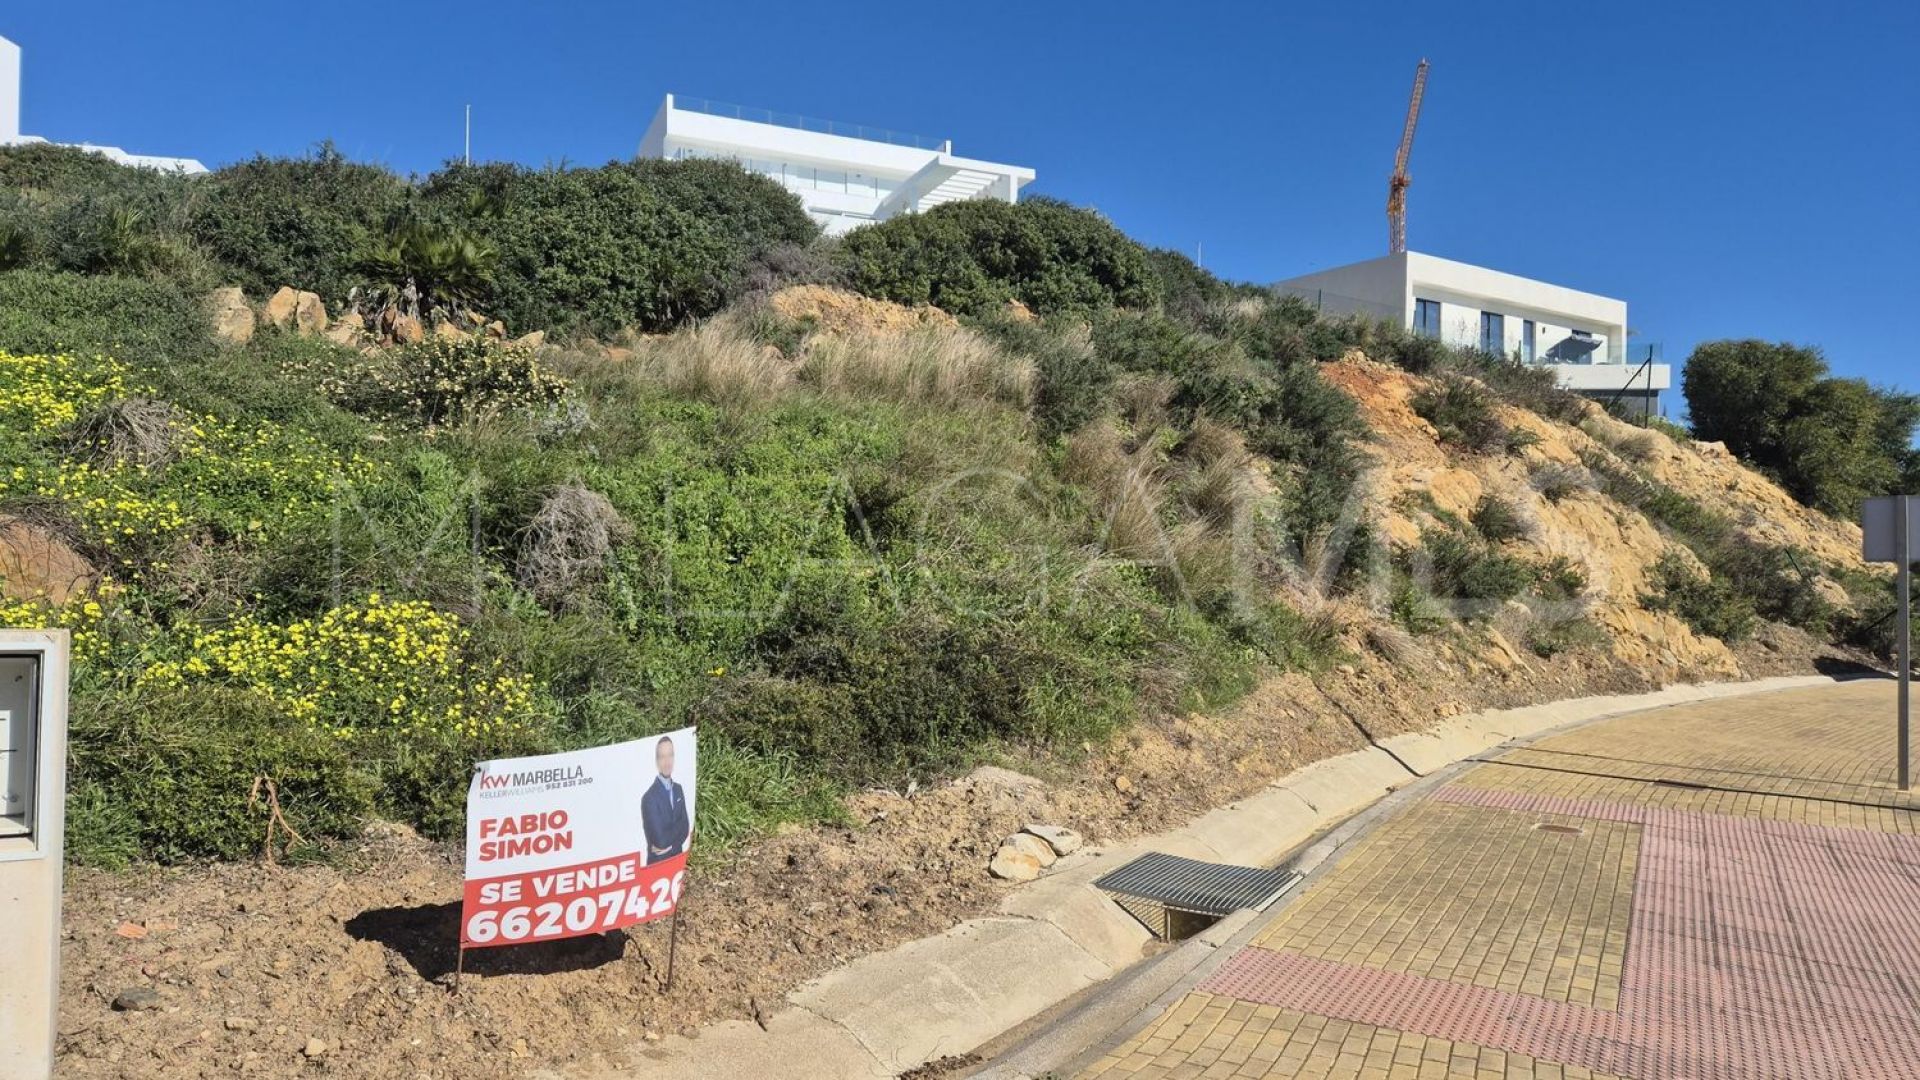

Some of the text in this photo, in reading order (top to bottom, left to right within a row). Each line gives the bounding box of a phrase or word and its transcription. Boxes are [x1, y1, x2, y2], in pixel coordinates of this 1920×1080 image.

[512, 765, 584, 787] MARBELLA
[480, 809, 568, 839] FABIO
[478, 830, 573, 862] SIMON
[479, 859, 636, 905] SE VENDE
